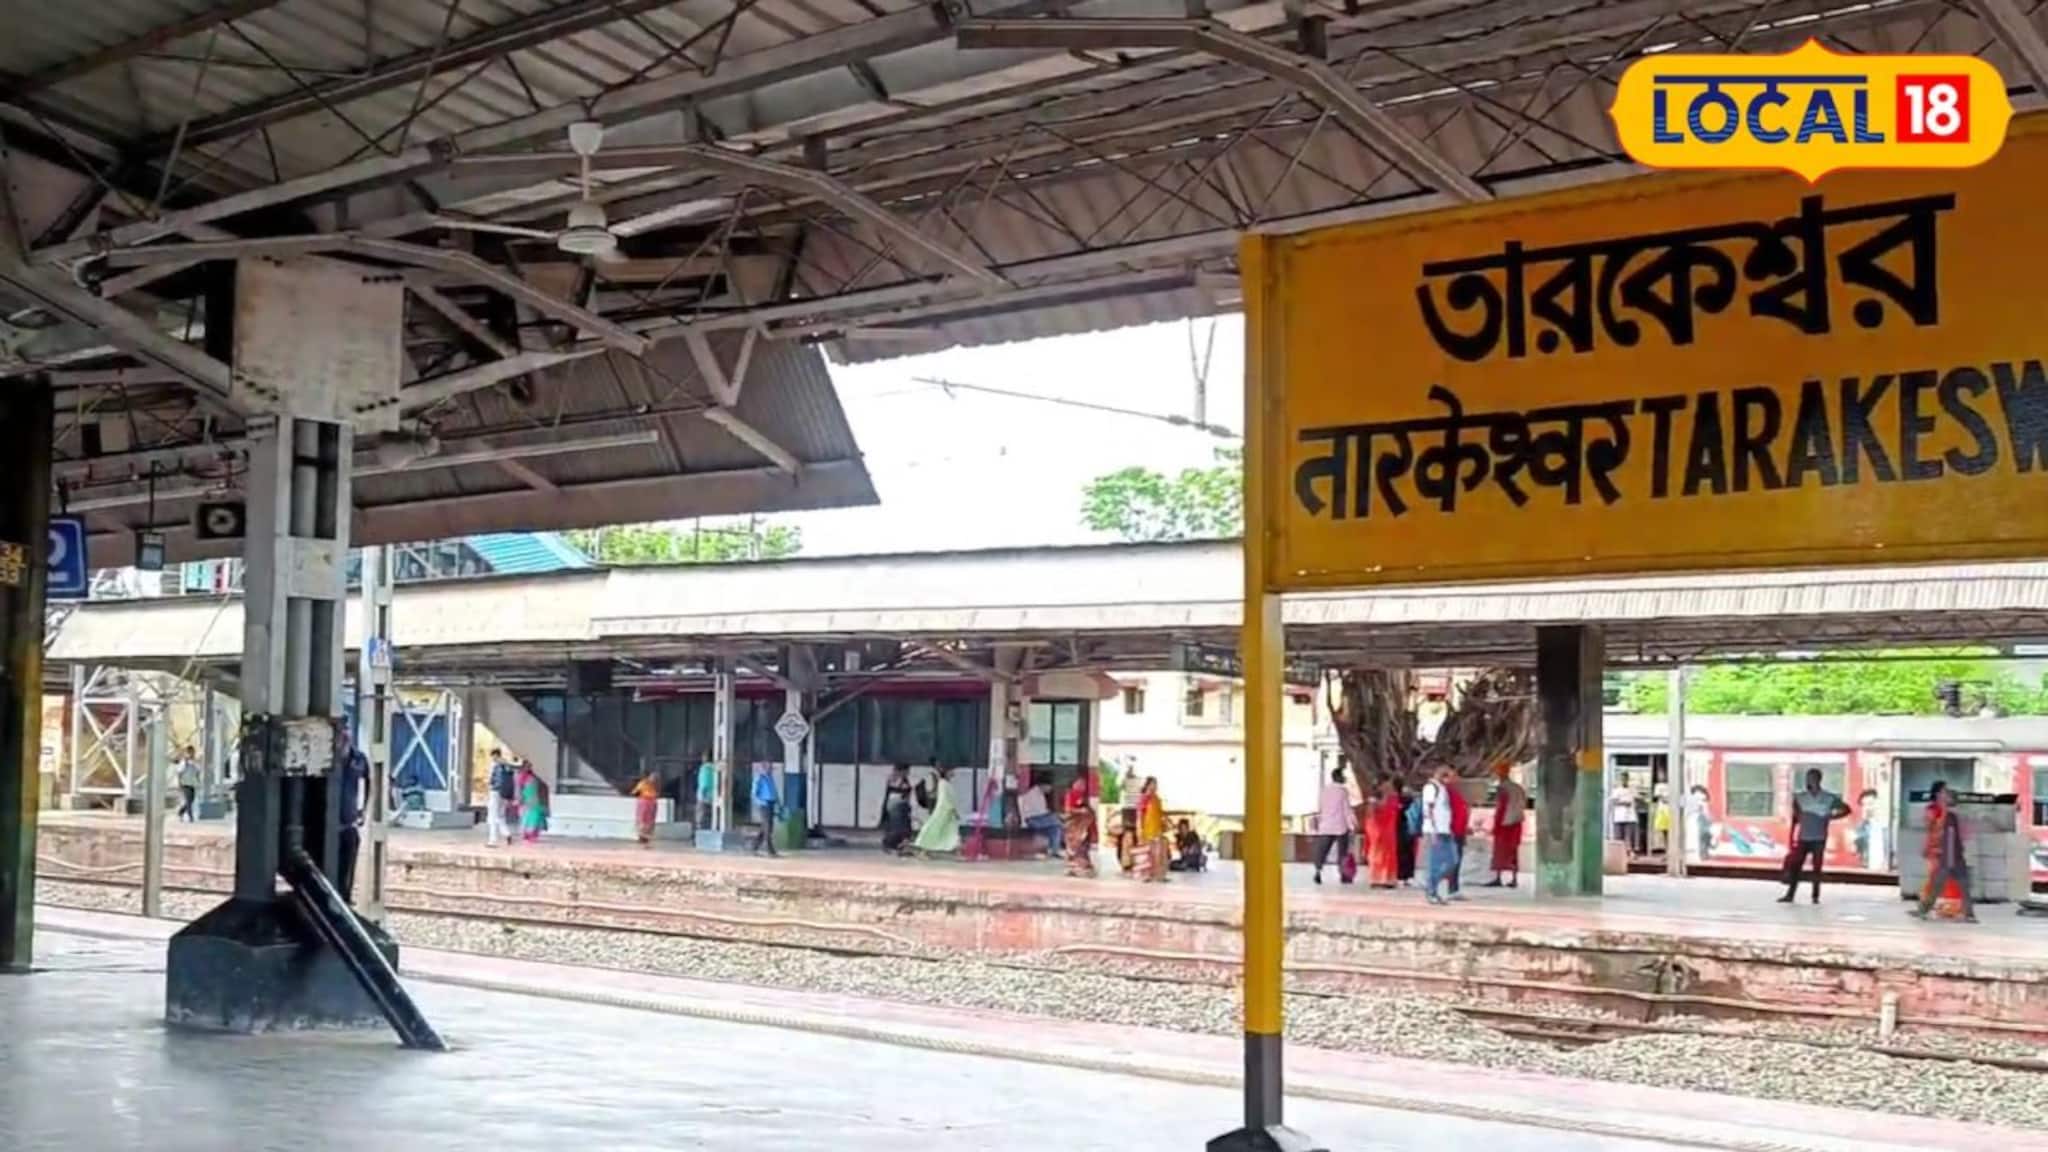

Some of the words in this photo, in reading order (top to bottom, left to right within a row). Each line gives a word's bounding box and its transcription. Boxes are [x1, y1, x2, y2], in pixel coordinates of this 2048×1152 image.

[1416, 194, 1957, 362] তারকেশ্বর
[1295, 384, 1635, 520] तारकेश्वर
[1641, 360, 2048, 499] TARAKESW
